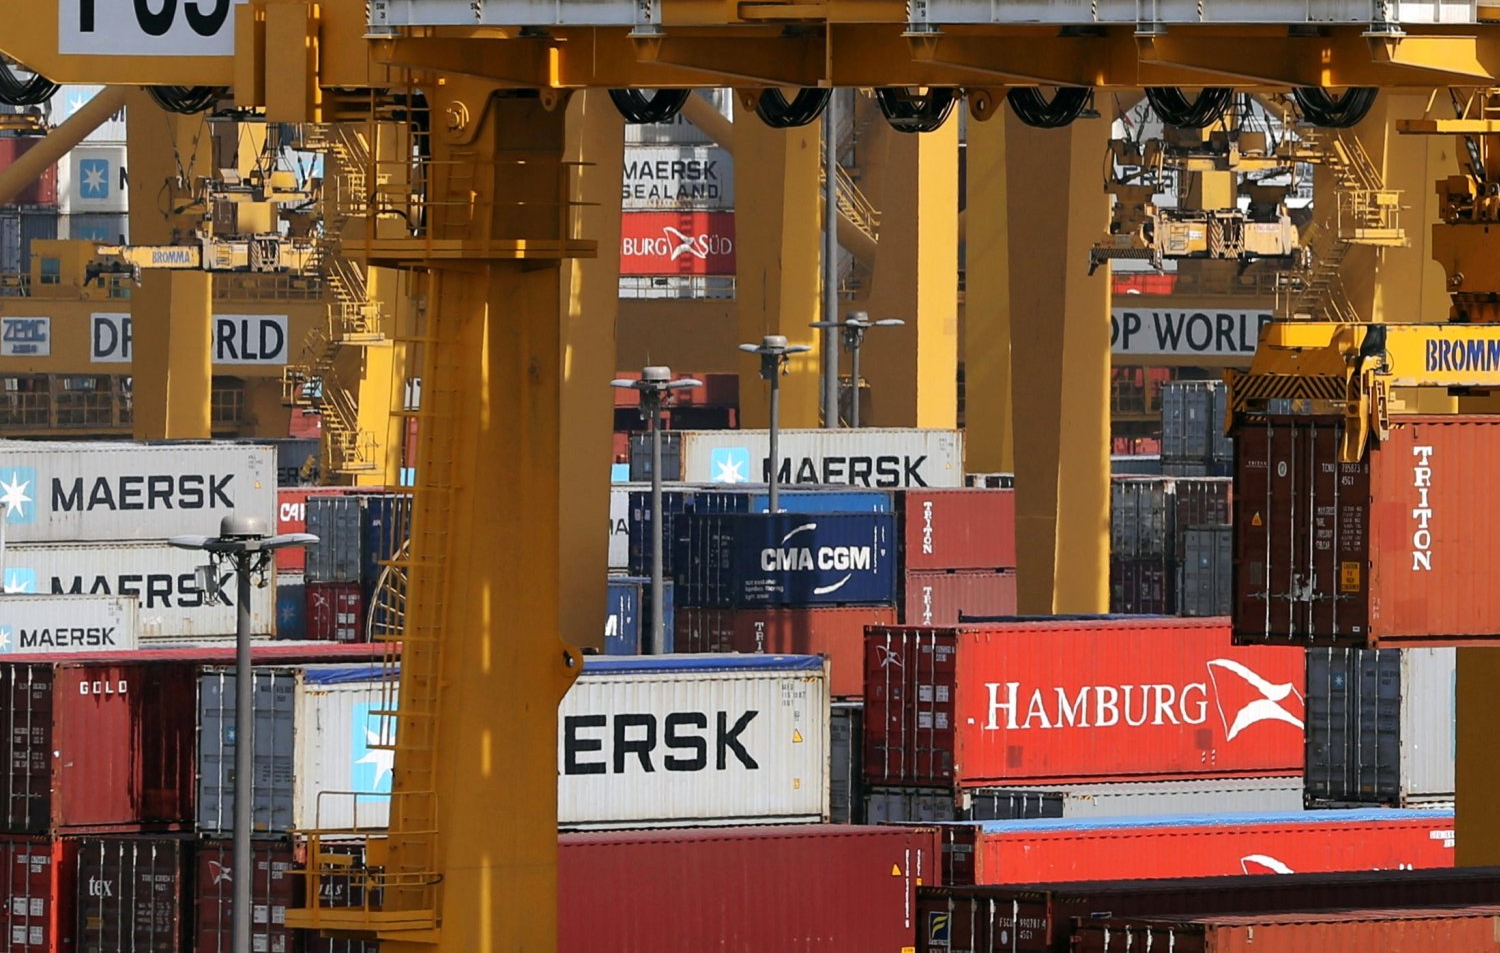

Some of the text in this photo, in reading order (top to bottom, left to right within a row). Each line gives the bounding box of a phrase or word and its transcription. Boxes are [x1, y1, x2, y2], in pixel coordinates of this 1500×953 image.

[152, 251, 191, 264] BROMMA
[764, 455, 928, 487] MAERSK
[51, 474, 235, 511] MAERSK
[1412, 446, 1432, 570] TRITON
[923, 502, 933, 554] TRITON
[761, 547, 814, 572] CMA
[818, 546, 871, 571] CGM
[20, 627, 115, 646] MAERSK
[80, 681, 128, 695] GOLD
[984, 682, 1208, 730] HAMBURG
[559, 711, 759, 775] ERSK
[89, 875, 112, 897] tex
